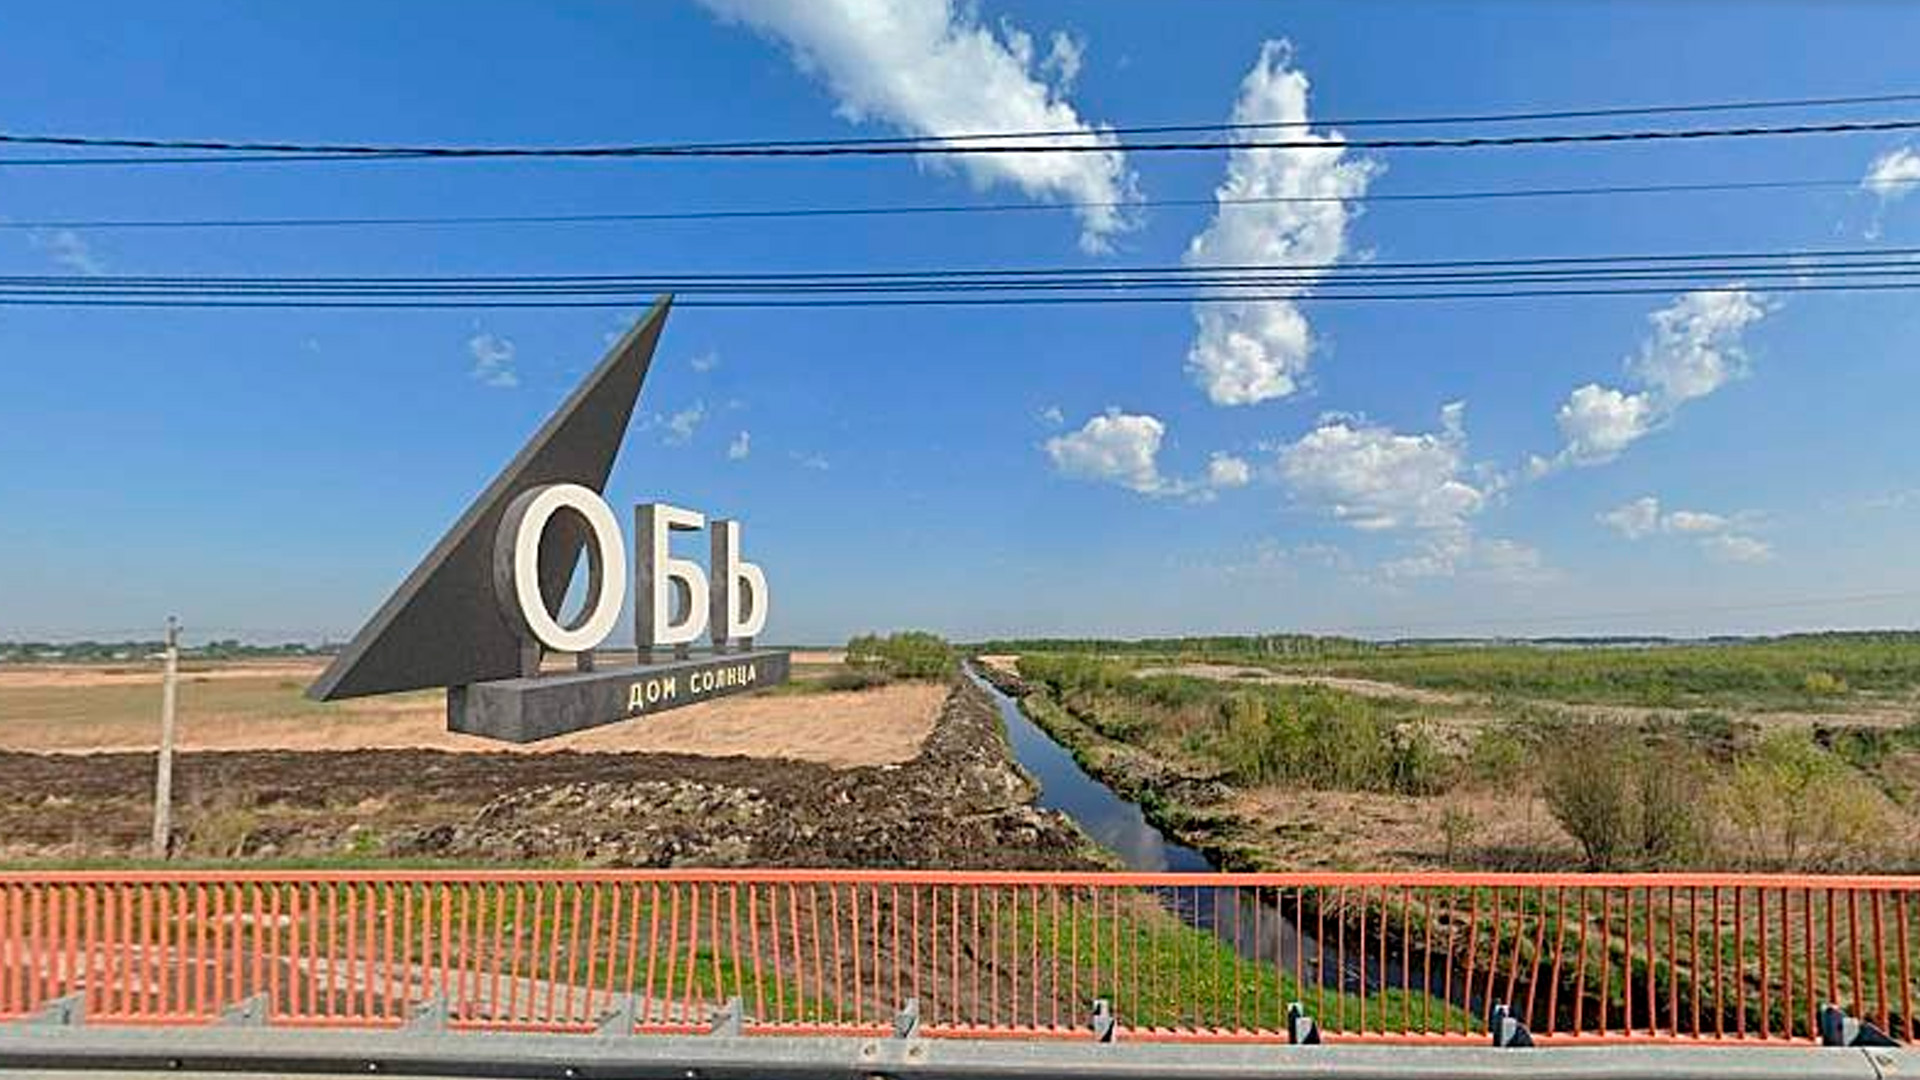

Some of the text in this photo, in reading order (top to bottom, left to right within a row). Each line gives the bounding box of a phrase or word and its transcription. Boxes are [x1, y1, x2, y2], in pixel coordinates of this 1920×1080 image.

[512, 483, 769, 651] ОБЬ
[627, 664, 757, 711] ДОМ СОЛНЦА
